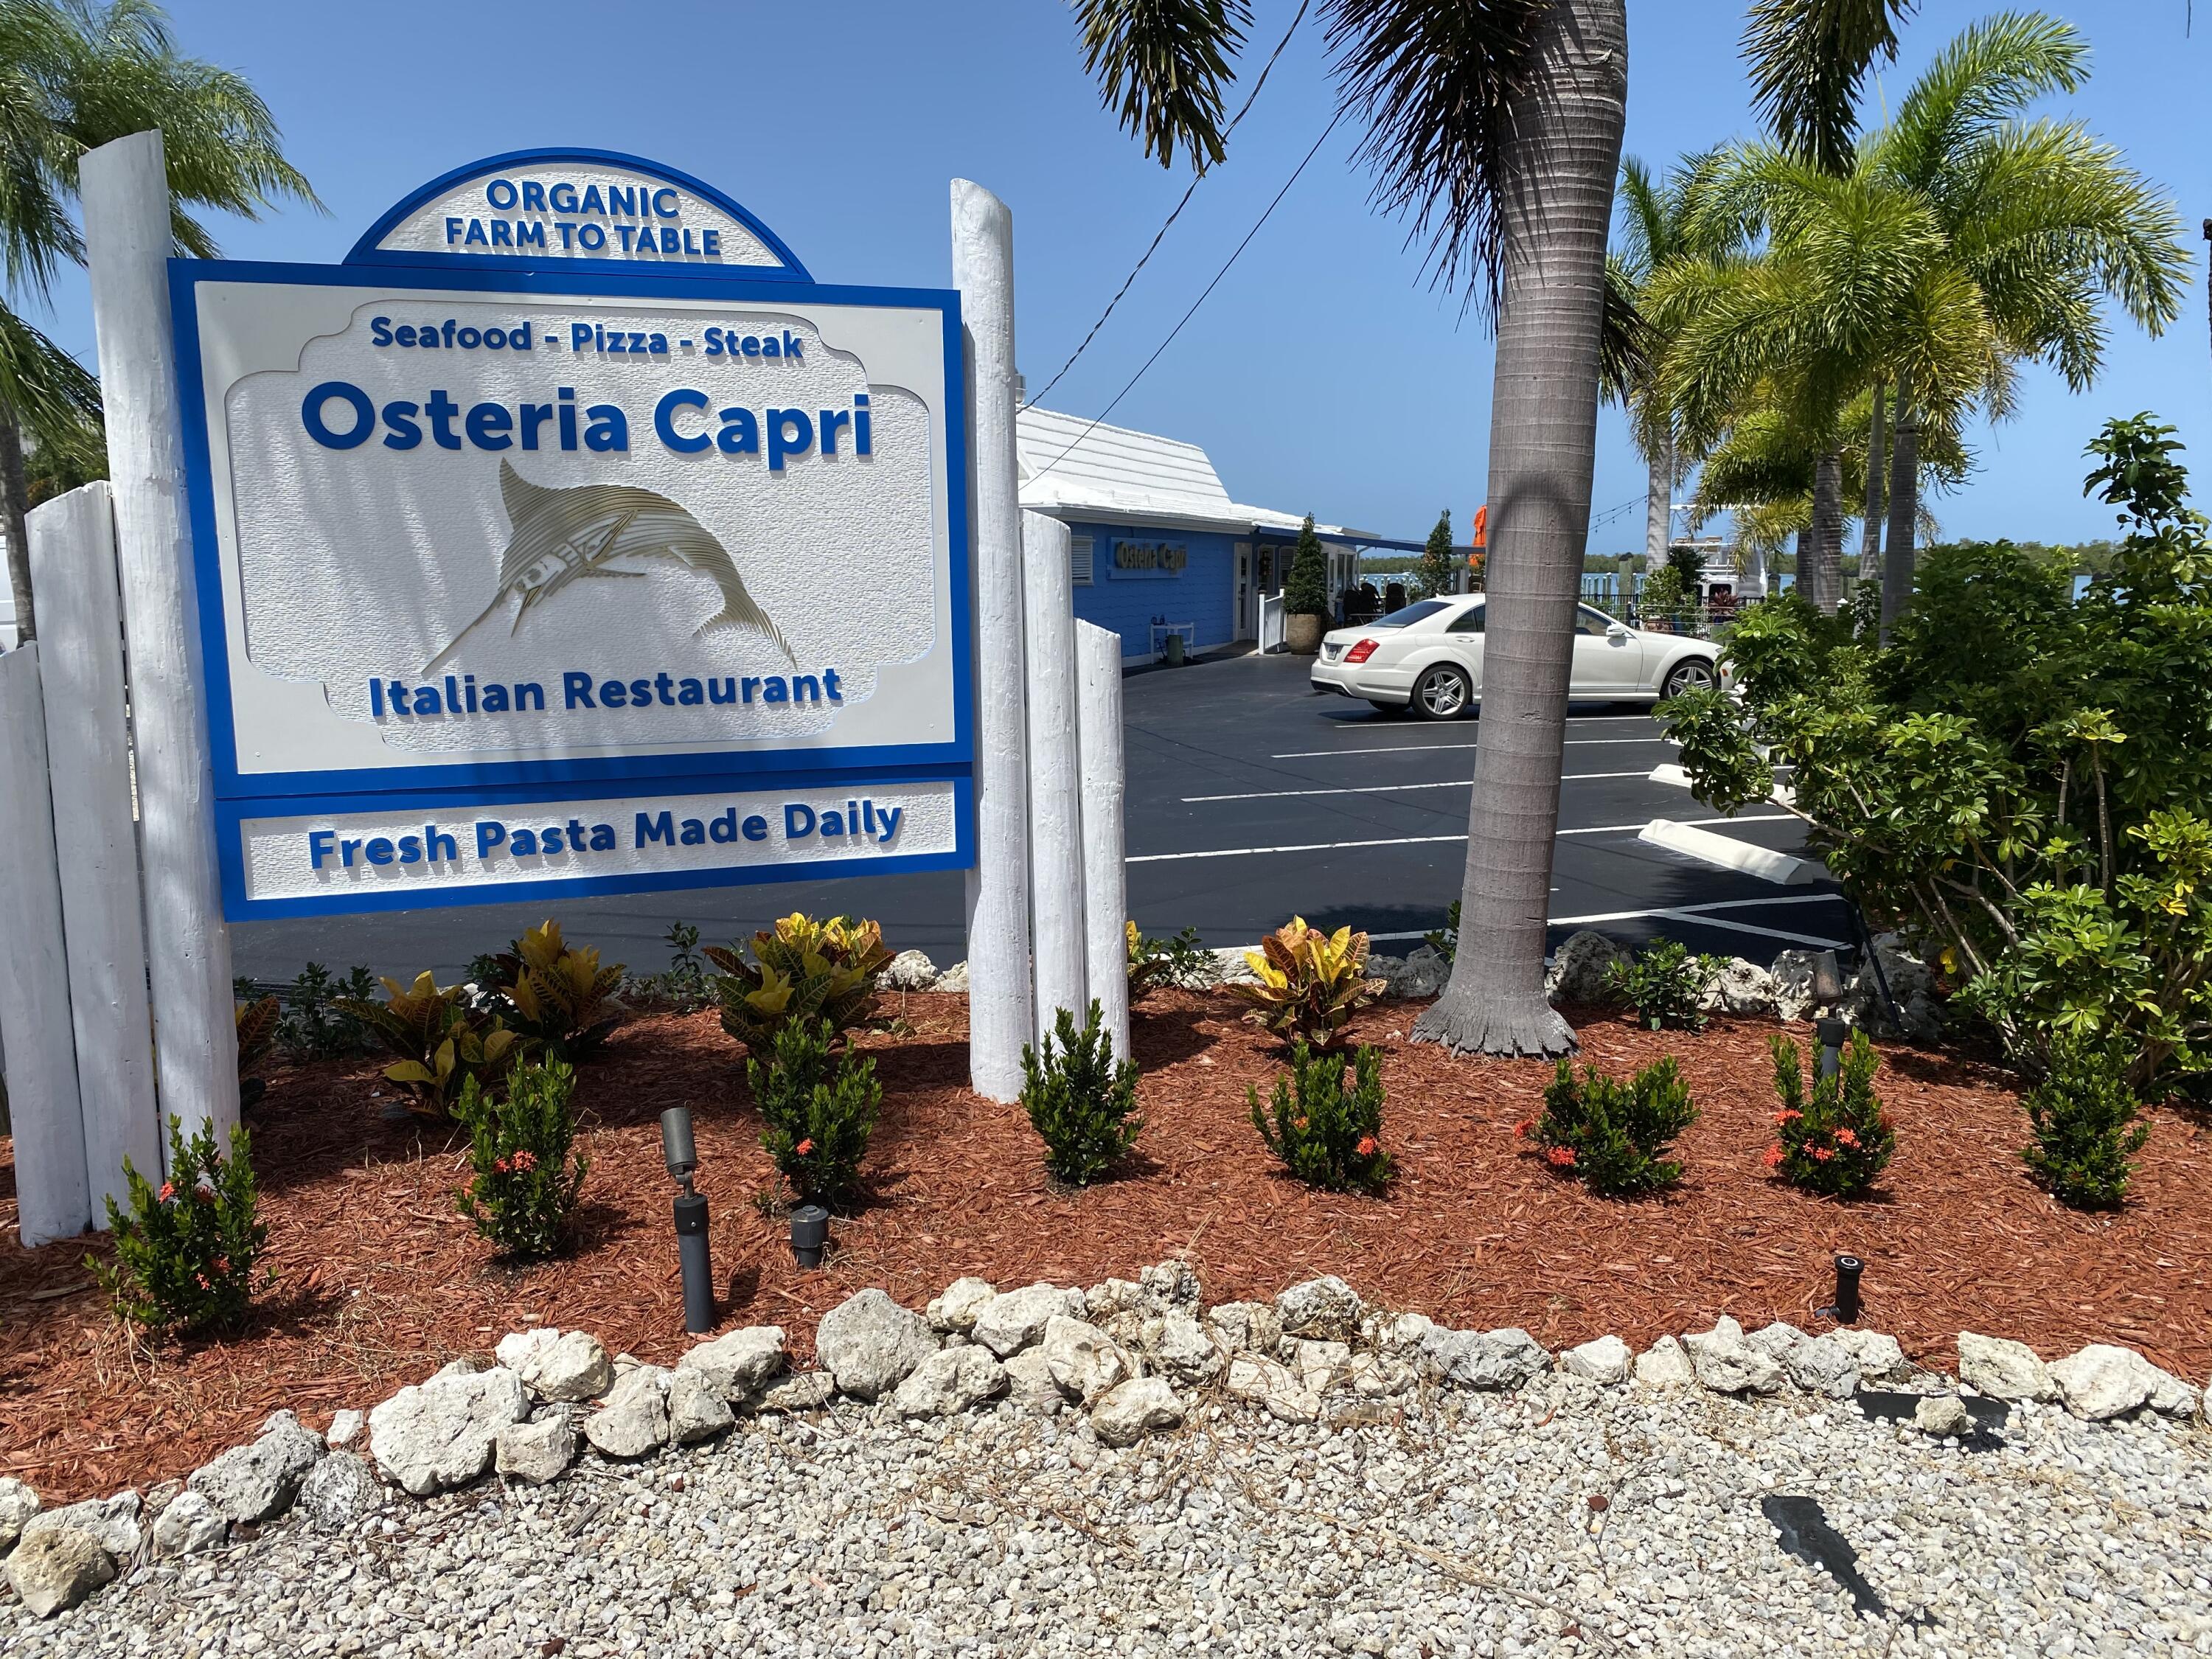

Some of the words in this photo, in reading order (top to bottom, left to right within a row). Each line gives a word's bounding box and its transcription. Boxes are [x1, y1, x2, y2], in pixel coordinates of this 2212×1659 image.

[487, 180, 679, 218] ORGANIC
[447, 218, 545, 247] FARM
[554, 223, 605, 250] TO
[613, 226, 720, 254] TABLE
[371, 317, 532, 349] Seafood
[571, 323, 667, 353] Pizza
[704, 328, 802, 357] Steak
[302, 381, 628, 451] Osteria
[655, 389, 871, 470] Capri
[1116, 542, 1157, 568] Osteria
[370, 677, 544, 716] Italian
[563, 669, 841, 709] Restaurant
[310, 826, 456, 869] Fresh
[476, 821, 616, 858] Pasta
[636, 808, 768, 848] Made
[785, 801, 901, 842] Daily
